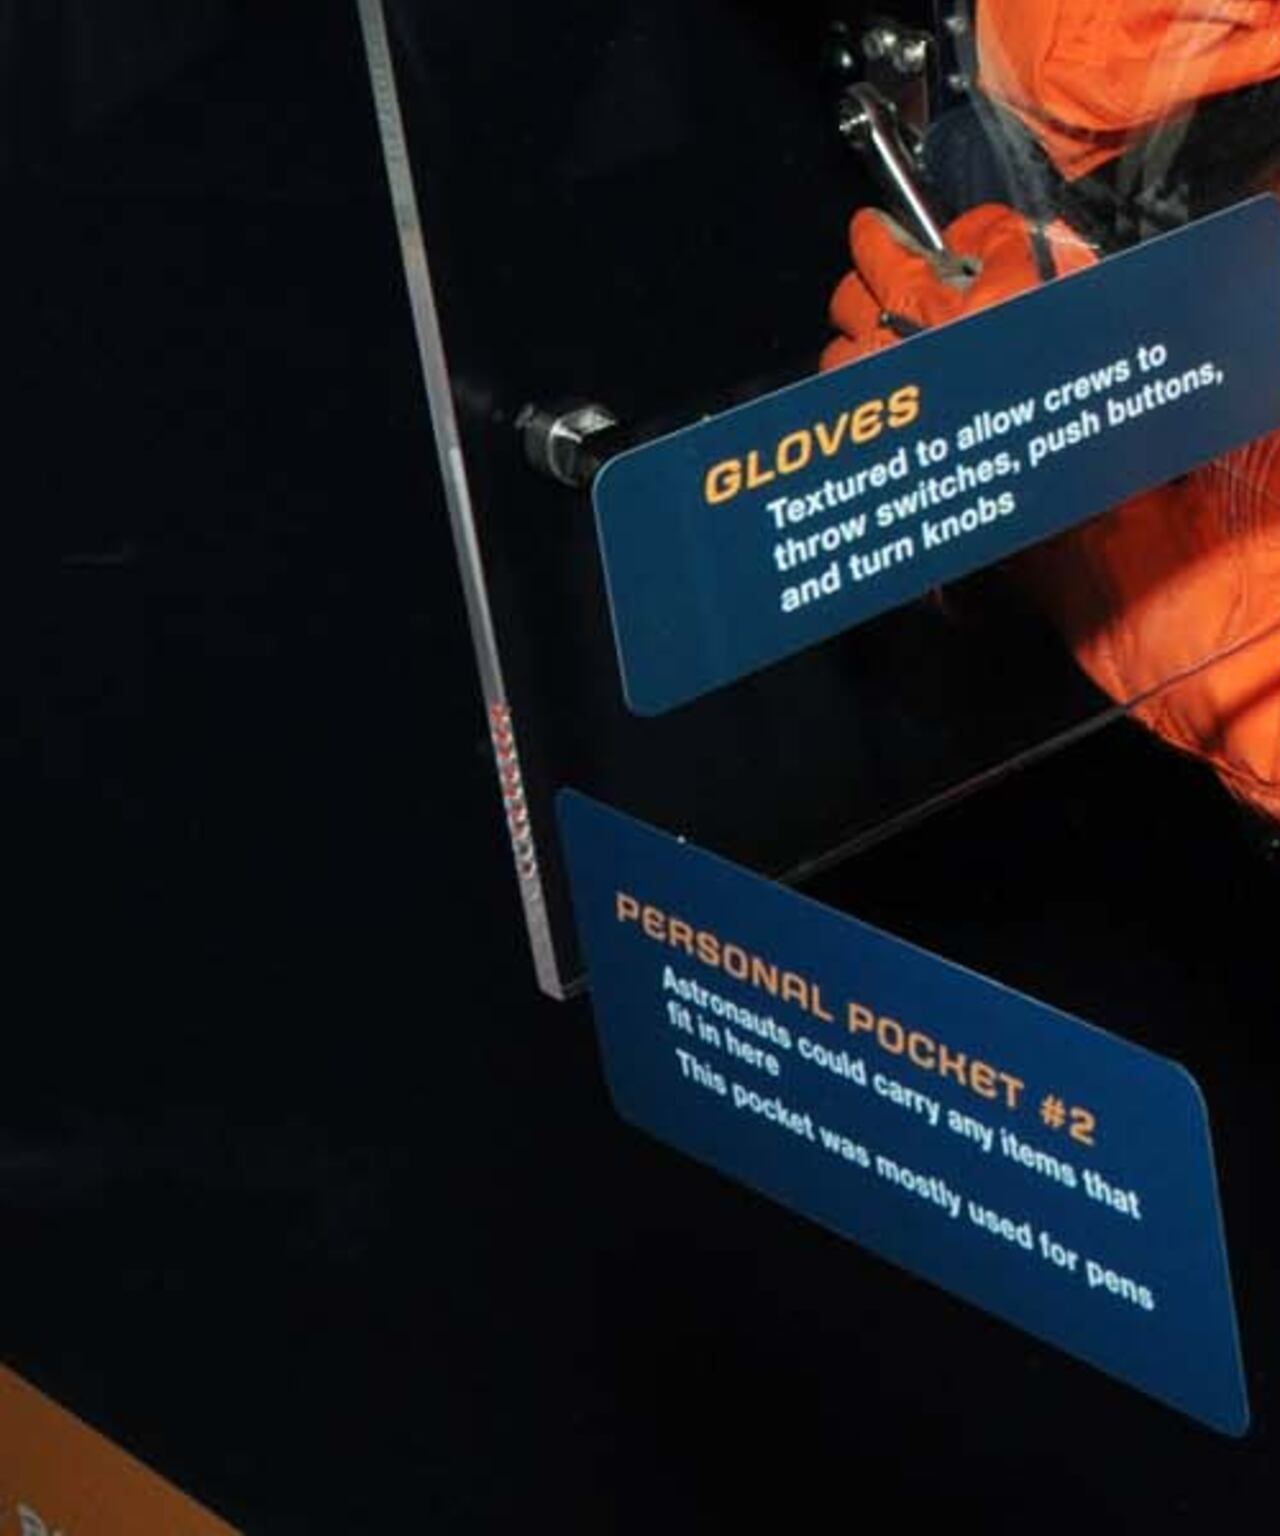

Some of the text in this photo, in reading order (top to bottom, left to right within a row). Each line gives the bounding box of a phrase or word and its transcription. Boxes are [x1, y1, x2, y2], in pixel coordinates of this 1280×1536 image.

[705, 384, 920, 504] GLOVES
[766, 343, 1168, 529] Textured to allow crews to
[773, 361, 1225, 571] throw switches, push buttons,
[781, 491, 1016, 613] and turn knobs
[616, 892, 1096, 1146] PERSONAL POCKET #2
[662, 965, 1141, 1220] Astronauts could carry any items that
[666, 999, 780, 1077] fit in here
[675, 1047, 1155, 1311] This pocket was mostly used for pens
